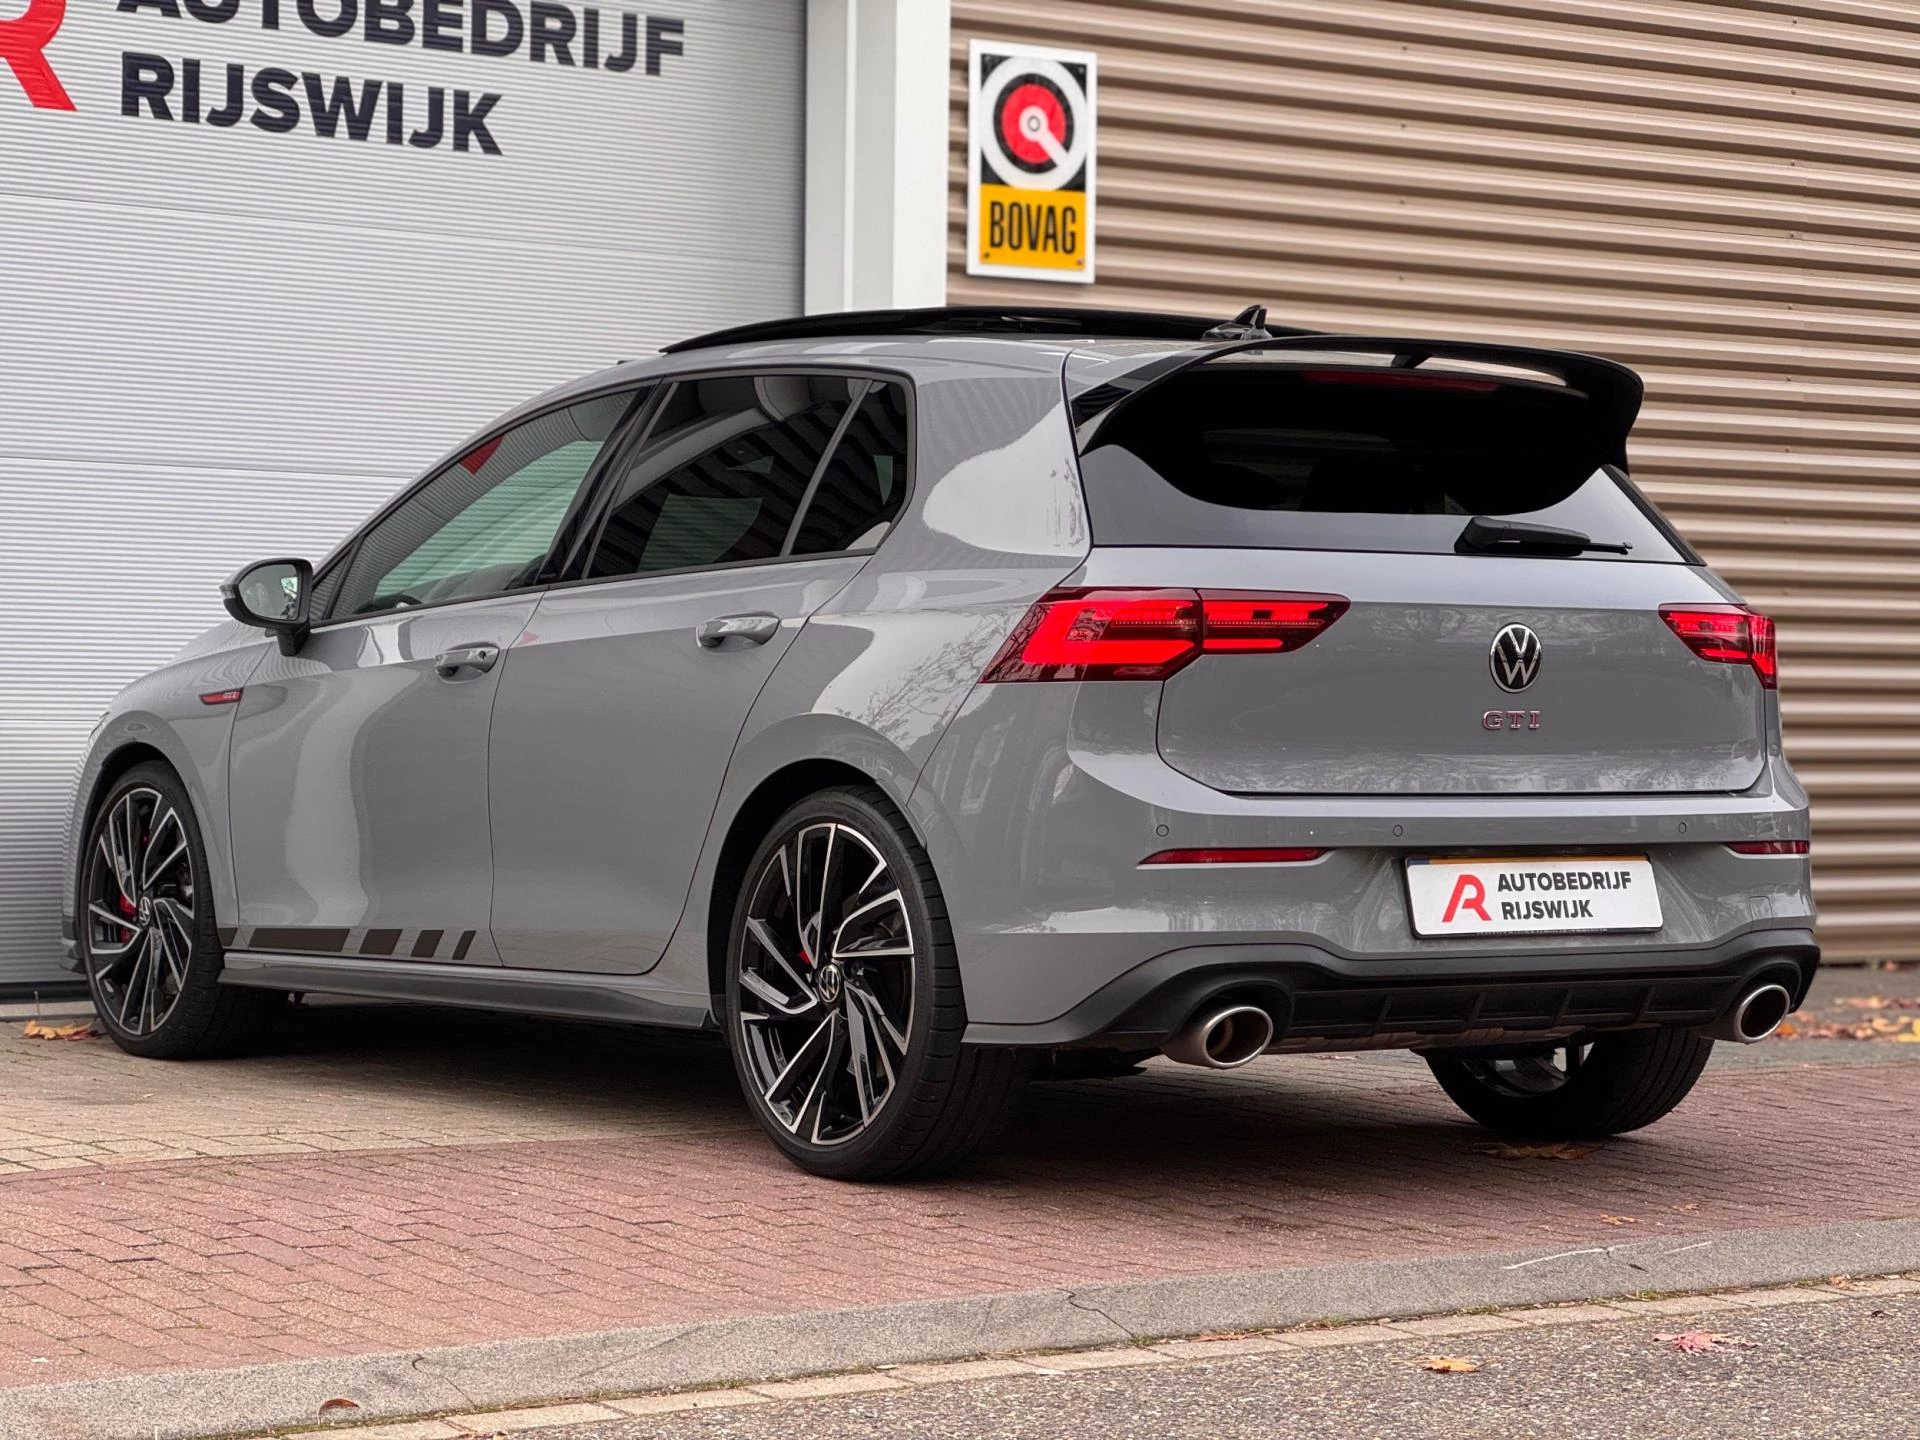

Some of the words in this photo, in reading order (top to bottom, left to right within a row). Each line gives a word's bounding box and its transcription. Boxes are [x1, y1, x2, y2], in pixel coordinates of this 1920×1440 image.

[121, 51, 503, 156] RIJSWIJK
[989, 201, 1076, 254] BOVAG
[1483, 710, 1541, 729] GTI
[1498, 872, 1631, 891] AUTOBEDRIJF
[1501, 900, 1593, 920] RIJSWIJK
